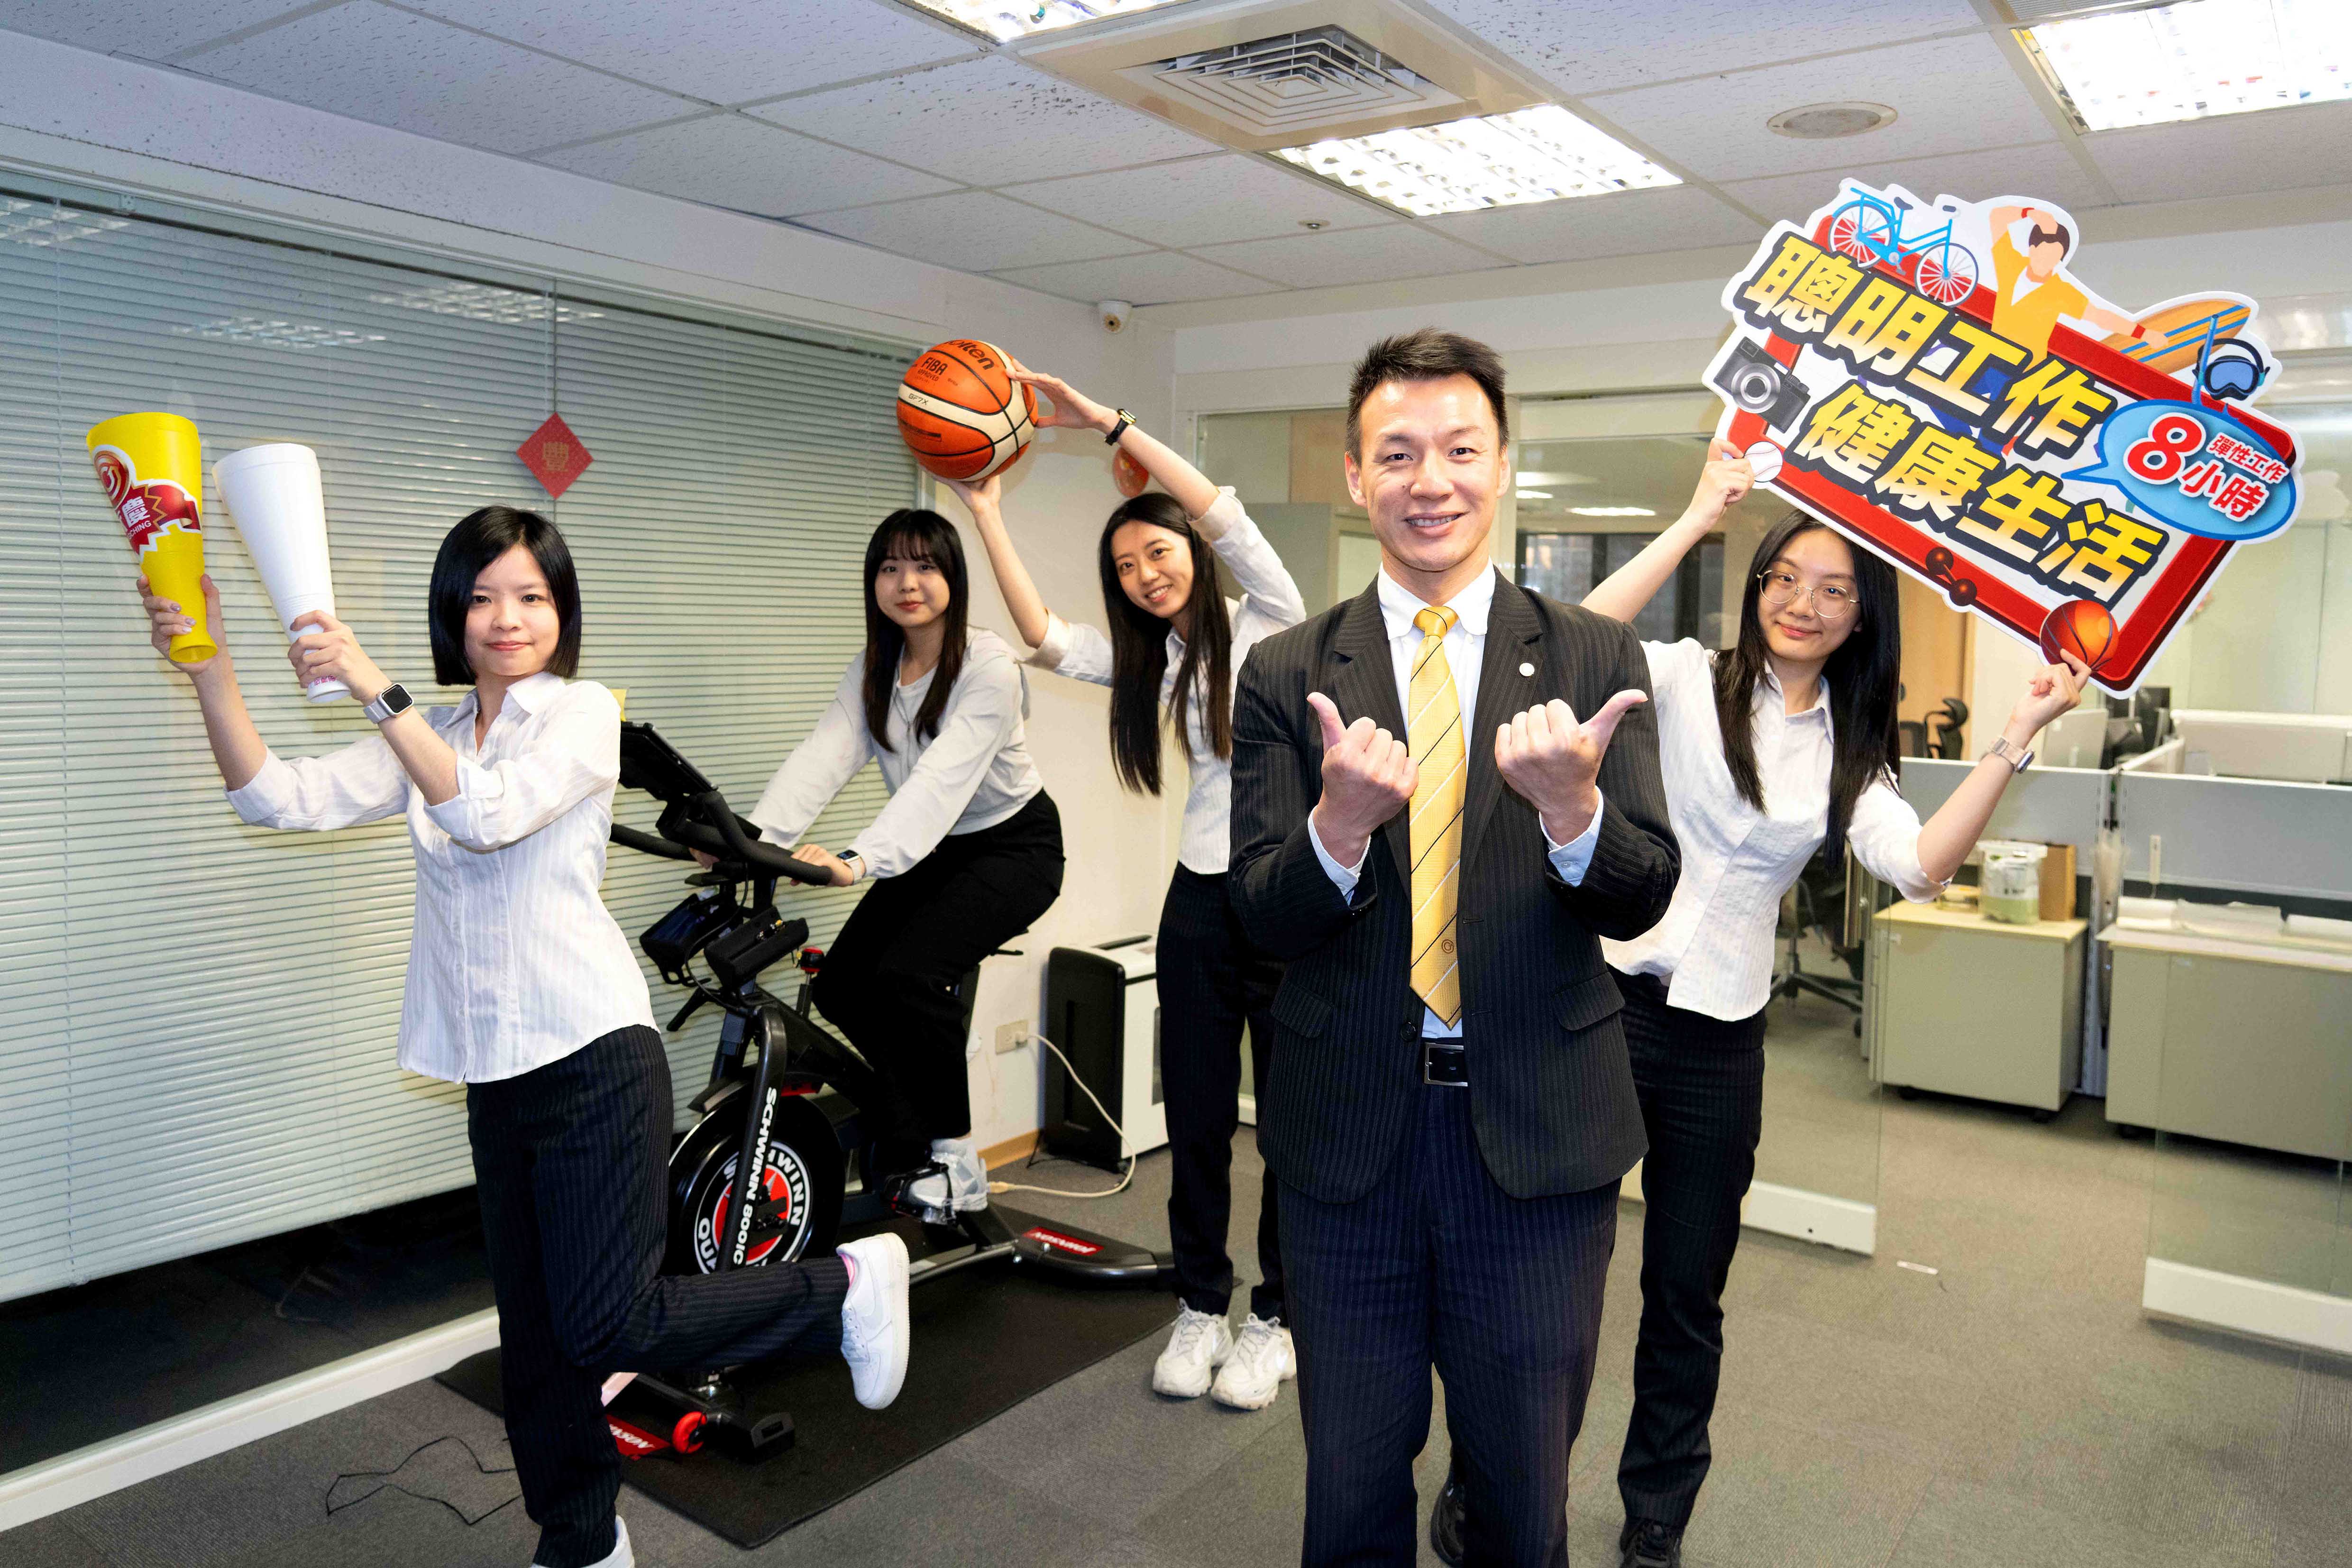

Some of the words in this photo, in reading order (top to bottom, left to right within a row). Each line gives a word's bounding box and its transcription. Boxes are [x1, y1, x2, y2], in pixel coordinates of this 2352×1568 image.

[947, 340, 994, 370] olten
[1743, 235, 2114, 451] 聰明工作
[917, 368, 939, 381] APPROVED
[921, 357, 948, 376] FIBA
[908, 393, 929, 405] GF7X
[2209, 435, 2287, 481] 彈性工作
[1794, 386, 2163, 601] 健康生活
[746, 1087, 777, 1201] SCHWINN
